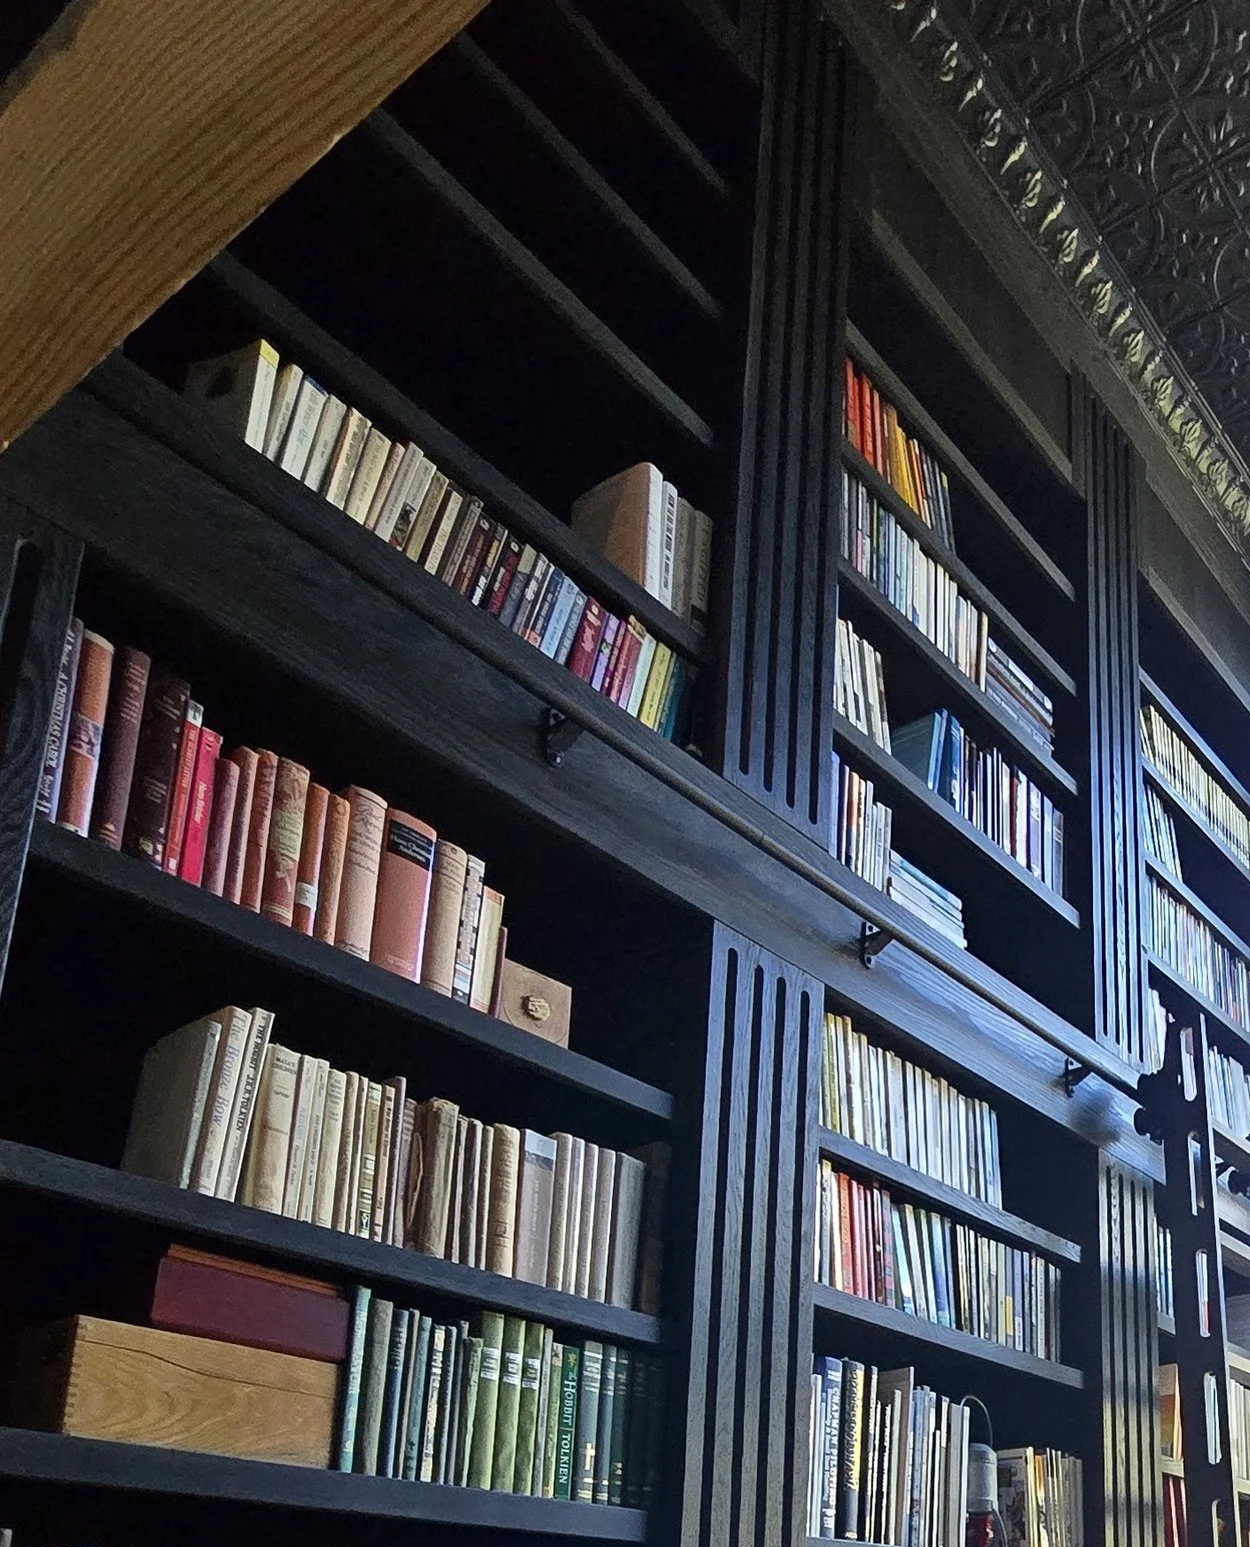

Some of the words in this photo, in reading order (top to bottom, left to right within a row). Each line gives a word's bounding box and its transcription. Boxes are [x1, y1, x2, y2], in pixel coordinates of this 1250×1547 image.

[48, 682, 68, 735] CHRISTMAS
[46, 736, 61, 769] CAROL
[230, 1013, 249, 1040] The
[254, 1023, 266, 1040] THE
[220, 1044, 242, 1089] Bronze
[248, 1040, 263, 1070] HOBBIT
[213, 1095, 231, 1128] Bow
[831, 1386, 840, 1445] CHAPMAN
[559, 1433, 571, 1484] TOLKIEN
[829, 1448, 838, 1507] PILOTING
